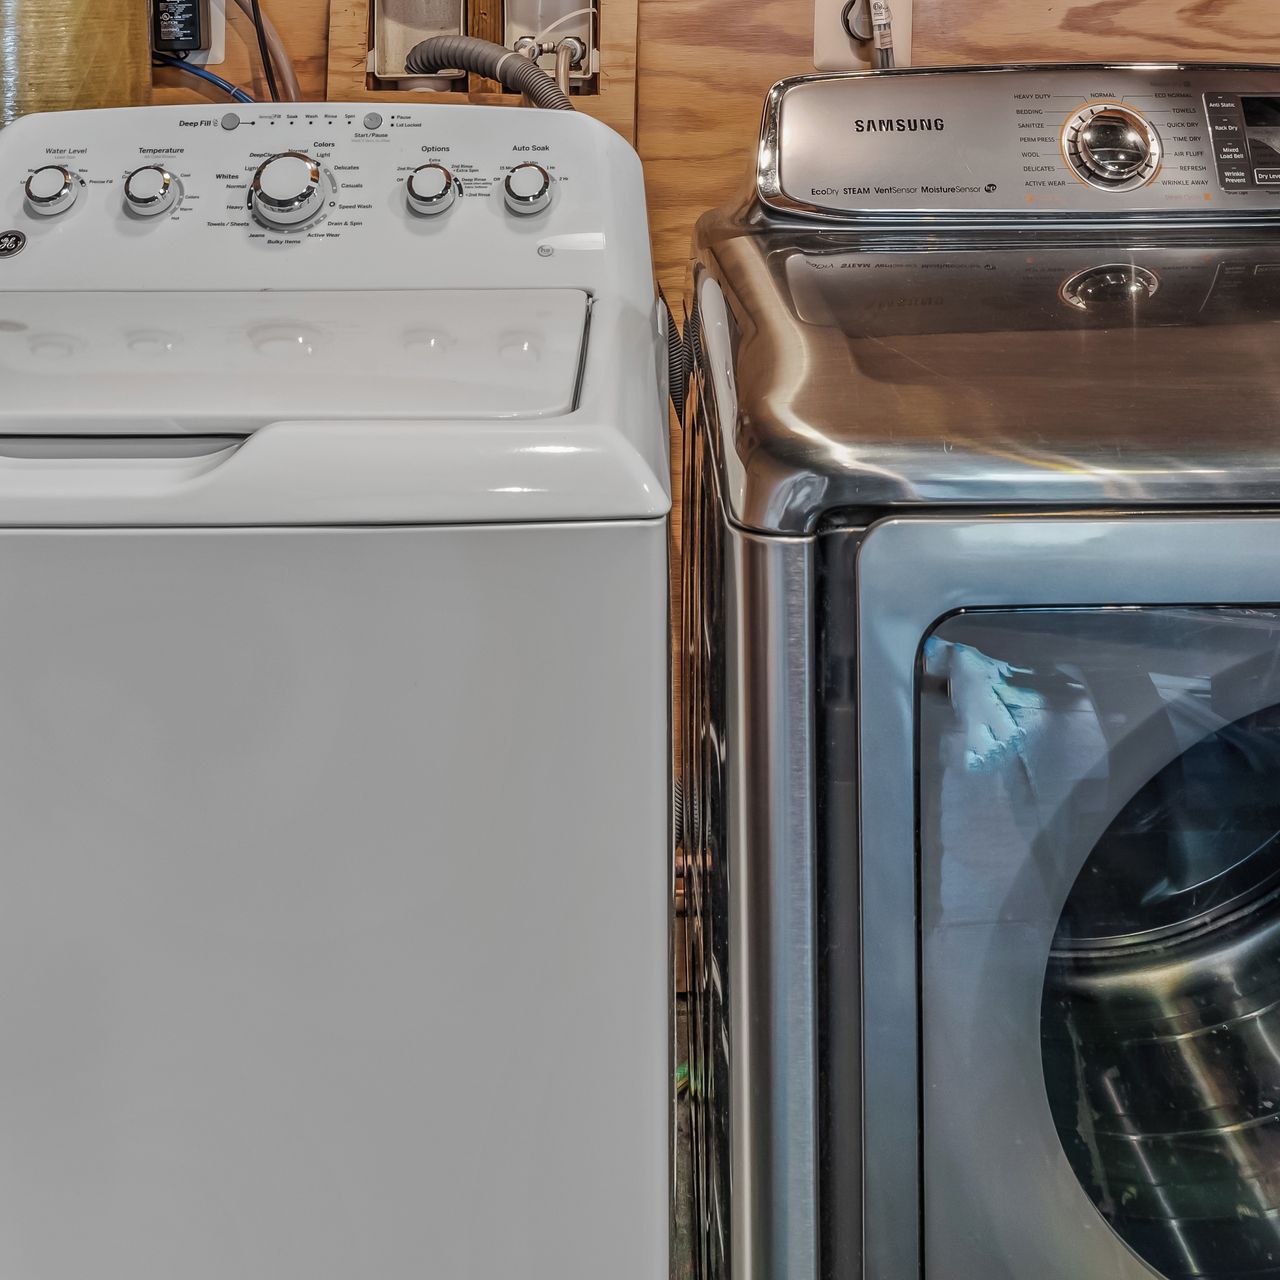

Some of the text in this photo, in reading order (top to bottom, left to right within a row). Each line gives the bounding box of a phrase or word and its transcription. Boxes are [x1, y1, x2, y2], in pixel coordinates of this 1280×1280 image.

[854, 118, 945, 132] SAMSUNG
[138, 147, 185, 155] Temperature
[421, 145, 450, 153] Options
[811, 185, 981, 196] EcoDry STEAM VentSensor MoistureSensor
